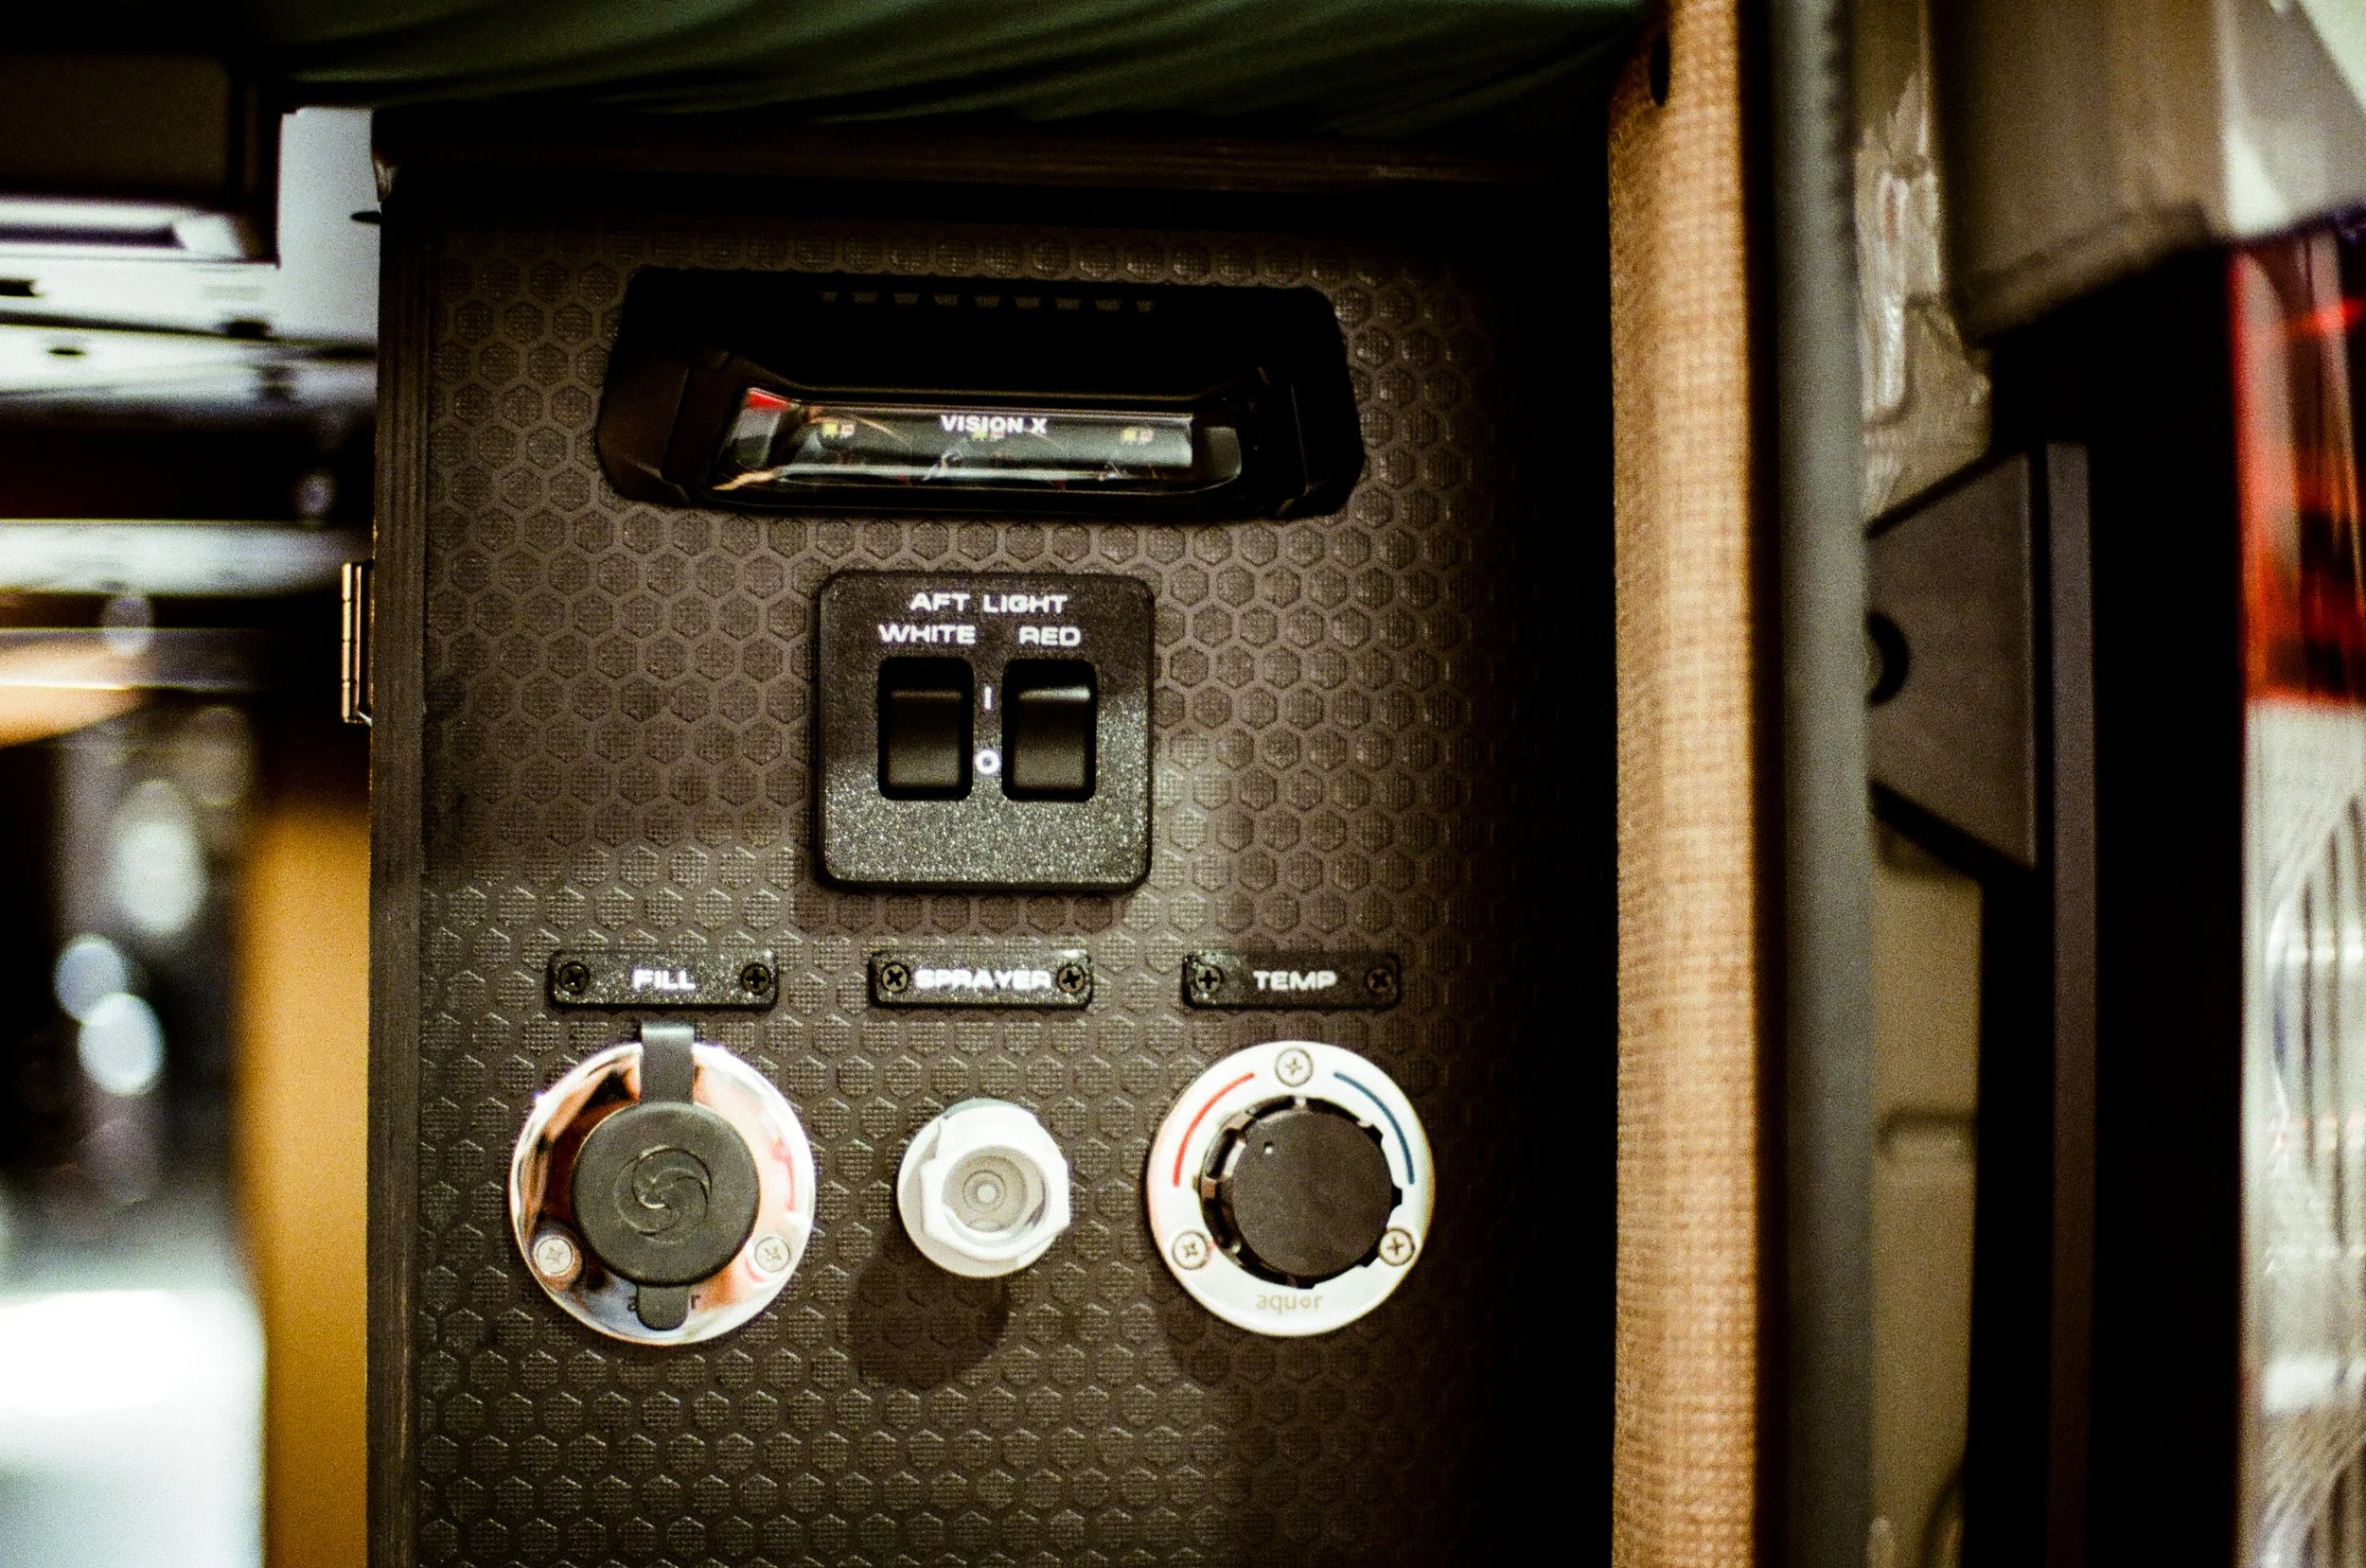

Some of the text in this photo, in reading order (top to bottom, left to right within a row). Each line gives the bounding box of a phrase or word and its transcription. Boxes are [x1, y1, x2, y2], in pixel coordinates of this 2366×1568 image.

[941, 414, 1048, 435] VISION X
[909, 592, 1068, 614] AFT LIGHT
[877, 624, 977, 645] WHITE
[1018, 625, 1082, 647] RED
[632, 968, 697, 991] FILL
[913, 967, 1052, 991] SPRAYER
[1252, 969, 1338, 992] TEMP
[1255, 1294, 1325, 1316] aquor
